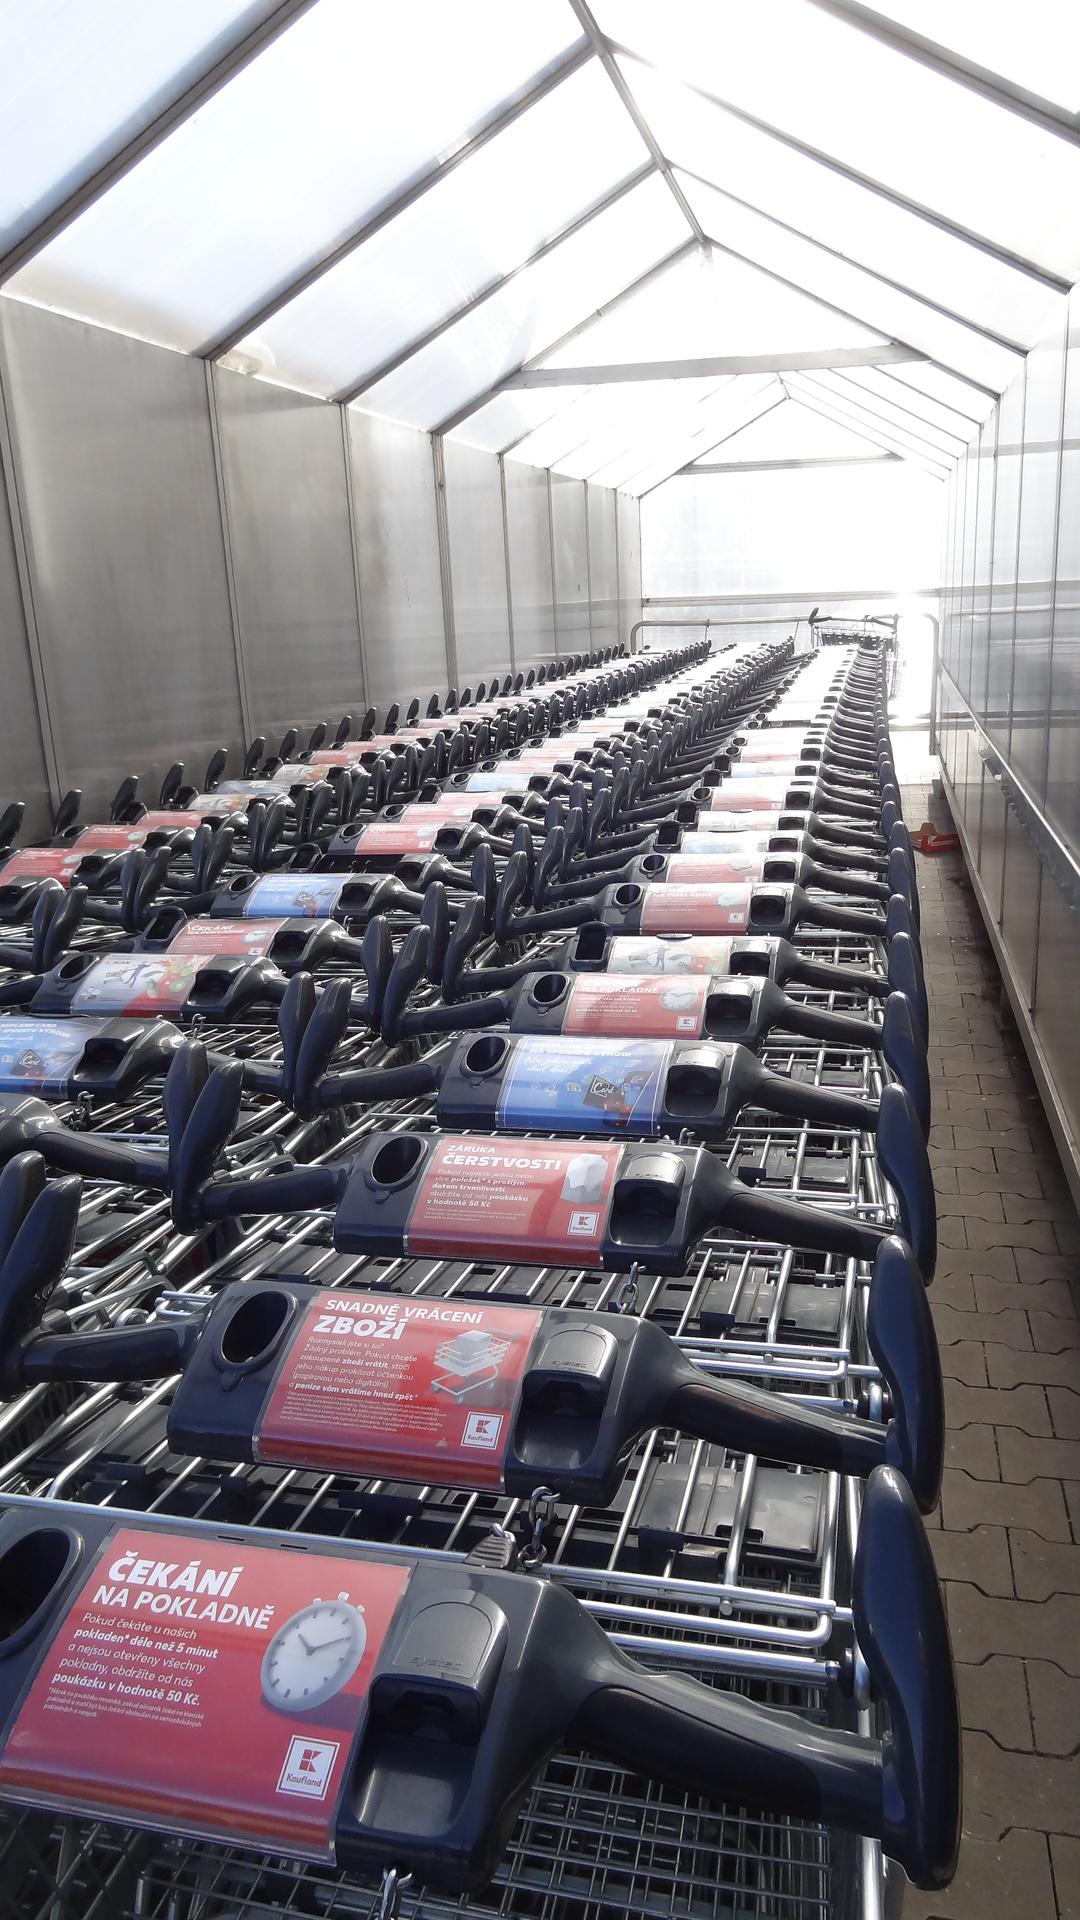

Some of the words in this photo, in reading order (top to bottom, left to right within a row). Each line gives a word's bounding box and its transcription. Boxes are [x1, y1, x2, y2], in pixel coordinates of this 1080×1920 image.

[594, 1082, 614, 1095] Card
[448, 1144, 496, 1154] ZÁRUKA
[442, 1152, 562, 1170] ČERSTVOSTI
[325, 1299, 400, 1316] SNADNÉ
[404, 1306, 484, 1324] VRÁCENÍ
[312, 1315, 408, 1340] ZBOŽÍ
[342, 1357, 364, 1366] zboží
[294, 1382, 321, 1391] peníze
[322, 1385, 339, 1393] vám
[341, 1387, 372, 1396] vrátíme
[373, 1390, 393, 1398] hned
[334, 1376, 354, 1385] nebo
[467, 1434, 494, 1442] Kaufland
[108, 1550, 244, 1597] ČEKÁNÍ
[92, 1585, 129, 1608] NA
[134, 1591, 275, 1630] POKLADNĚ
[82, 1613, 115, 1627] Pokud
[117, 1616, 152, 1632] čekáte
[154, 1626, 162, 1634] u
[163, 1626, 197, 1640] našich
[130, 1636, 153, 1648] déle
[155, 1640, 175, 1650] než
[175, 1642, 184, 1653] 5
[185, 1647, 219, 1658] minut
[77, 1644, 111, 1657] nejsou
[113, 1650, 160, 1667] otevřeny
[162, 1658, 206, 1674] všechny
[59, 1657, 109, 1675] pokladny,
[111, 1665, 156, 1681] obdržíte
[157, 1672, 172, 1684] od
[174, 1676, 193, 1688] nás
[52, 1672, 106, 1690] poukázku
[109, 1682, 116, 1690] v
[117, 1684, 164, 1700] hodnotě
[166, 1691, 181, 1702] 50
[183, 1694, 200, 1706] Kč.
[286, 1773, 322, 1788] Kaufland
